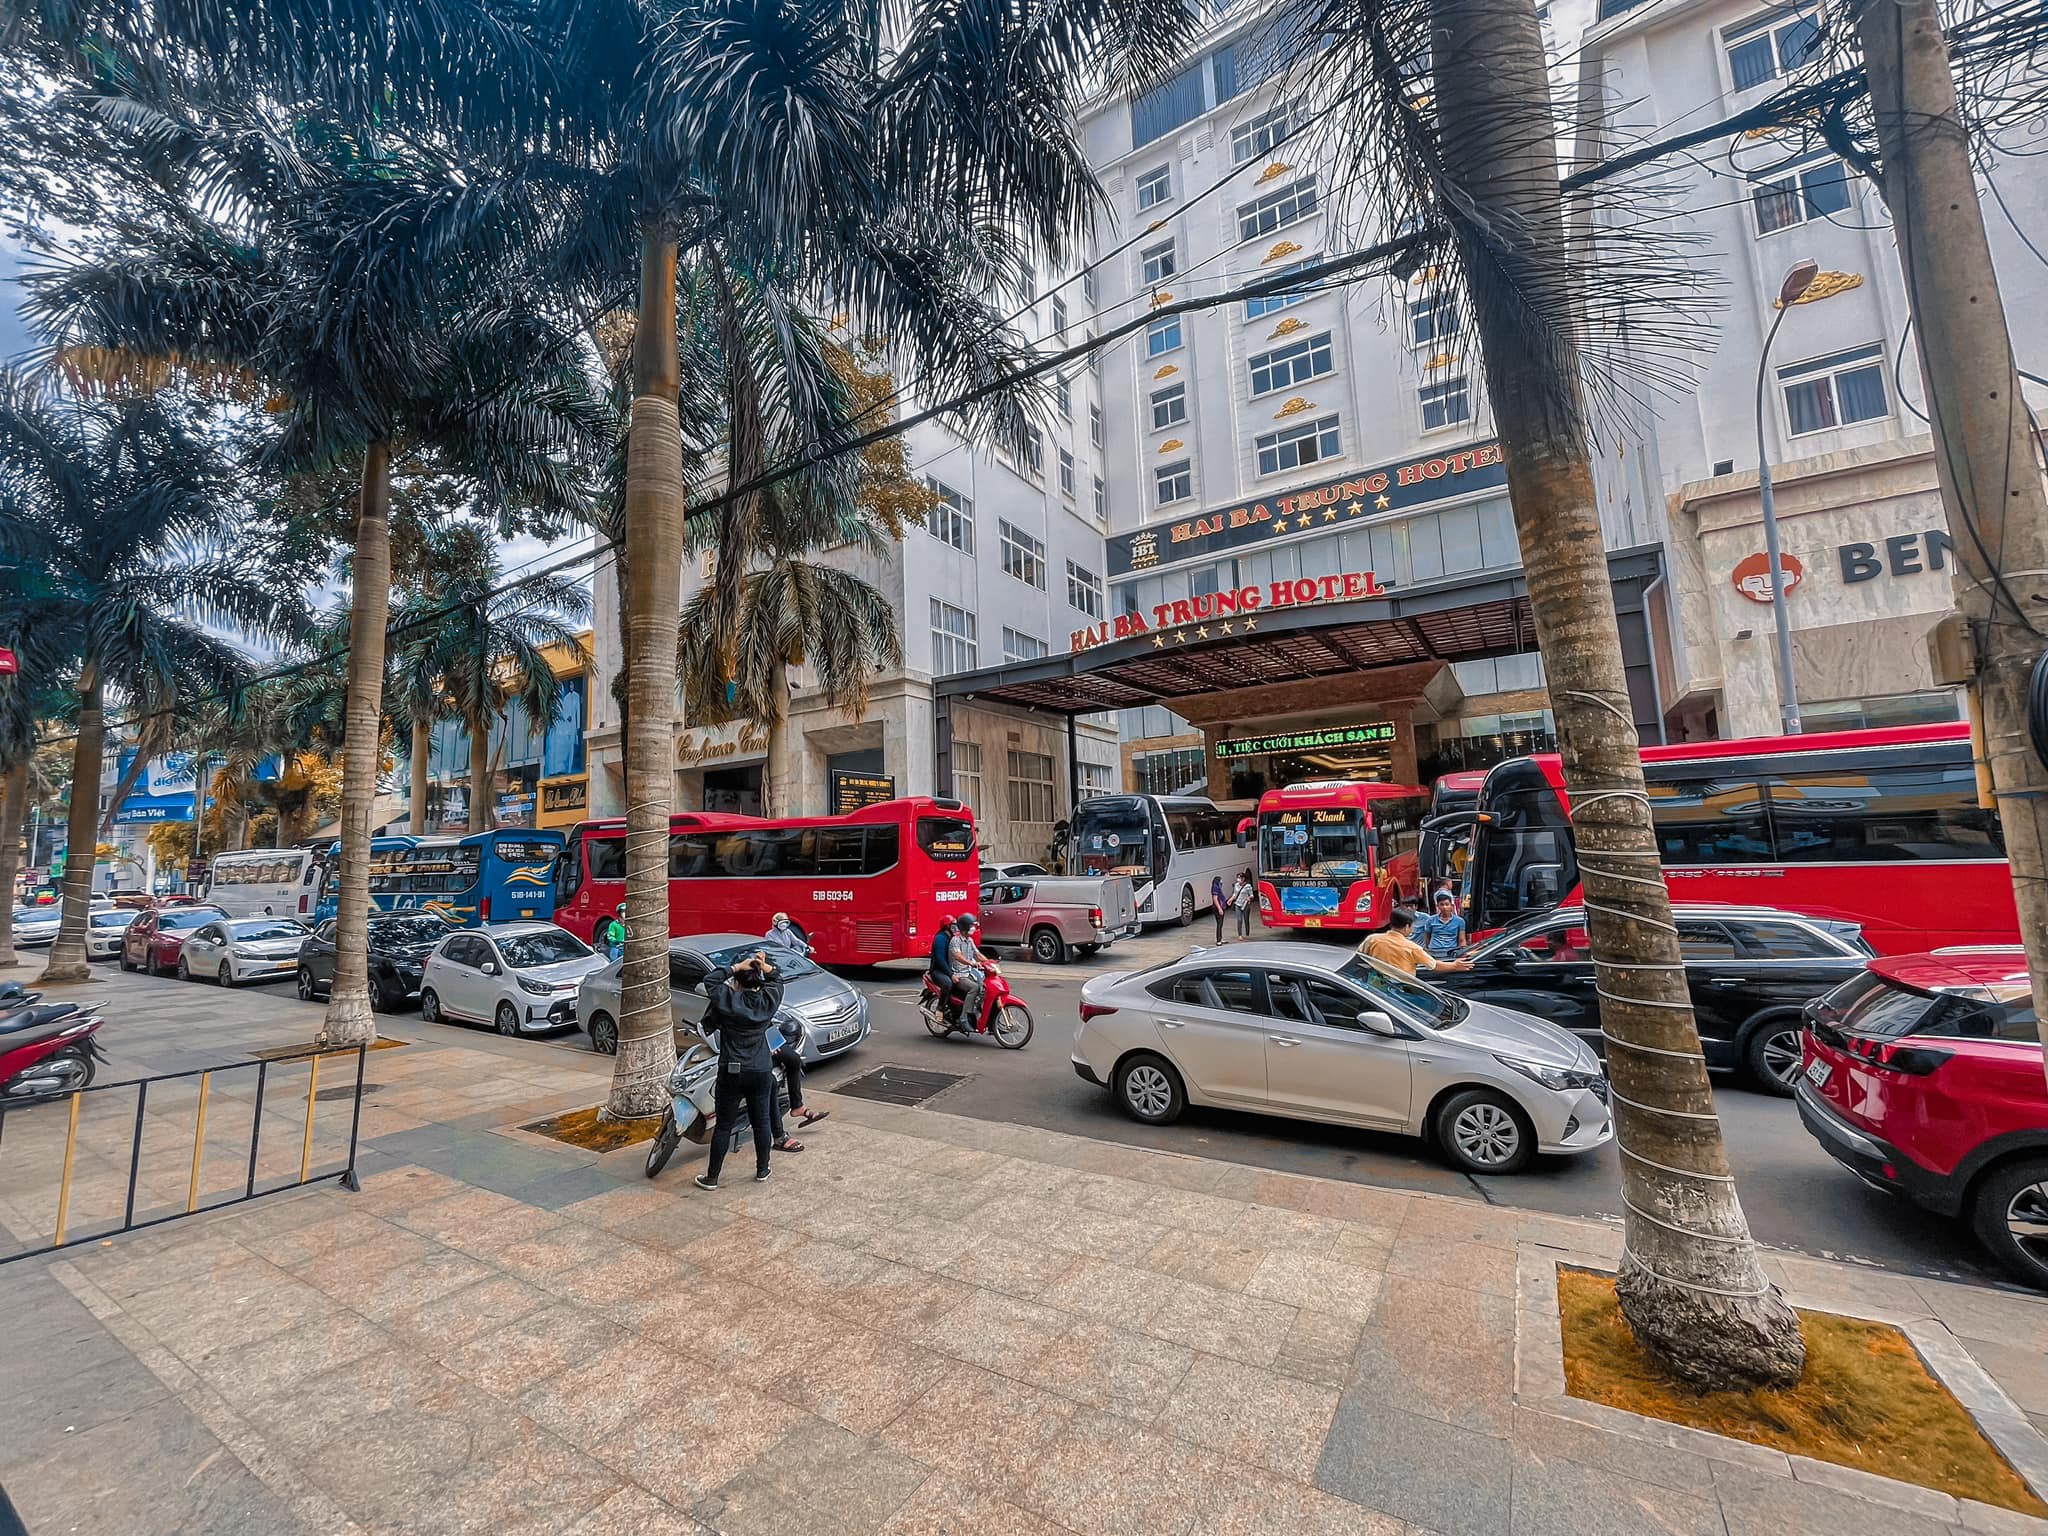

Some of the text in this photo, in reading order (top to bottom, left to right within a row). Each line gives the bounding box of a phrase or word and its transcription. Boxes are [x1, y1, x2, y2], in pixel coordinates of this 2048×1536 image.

[1171, 514, 1223, 543] HAI
[1229, 504, 1272, 528] BA
[1277, 473, 1390, 513] TRUNG
[1132, 543, 1156, 557] HBT
[1070, 571, 1385, 652] HAI BA TRUNG HOTEL
[1294, 732, 1344, 747] KHÁCH
[1346, 727, 1377, 743] SẠN
[1279, 811, 1345, 825] Minh Khanh
